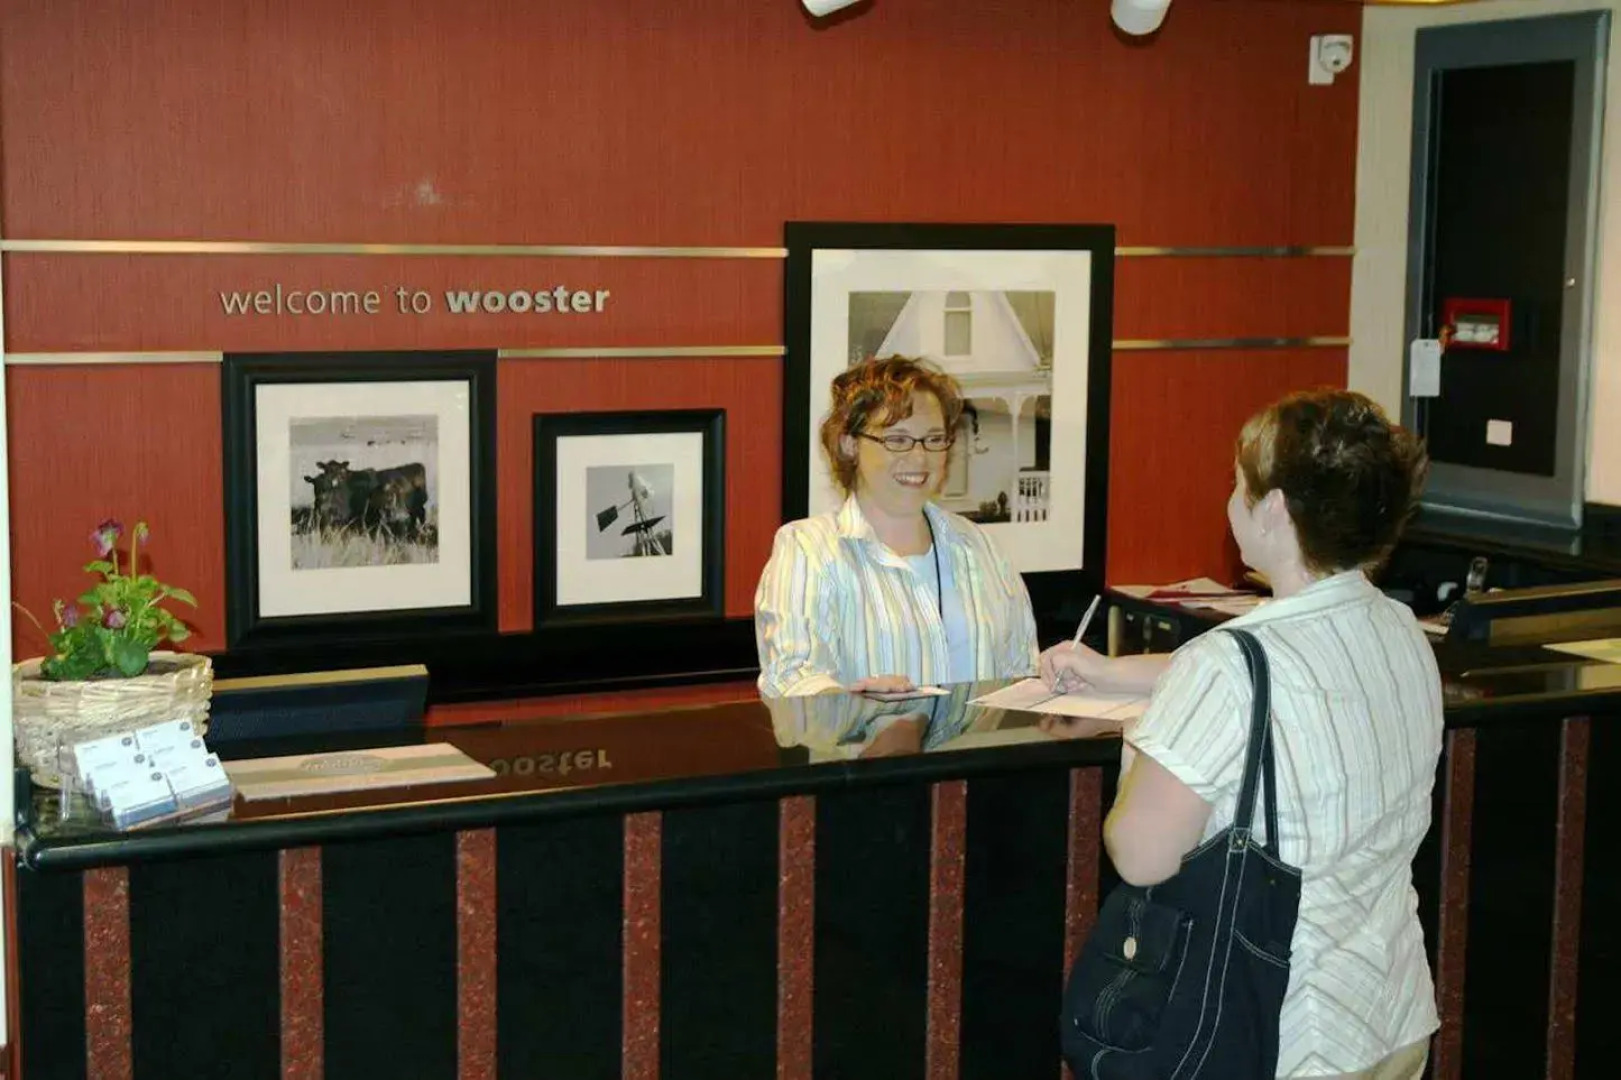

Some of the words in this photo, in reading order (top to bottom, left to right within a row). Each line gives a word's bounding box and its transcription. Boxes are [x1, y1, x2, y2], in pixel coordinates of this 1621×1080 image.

[221, 284, 381, 314] welcome
[397, 288, 431, 314] to
[446, 284, 611, 314] wooster
